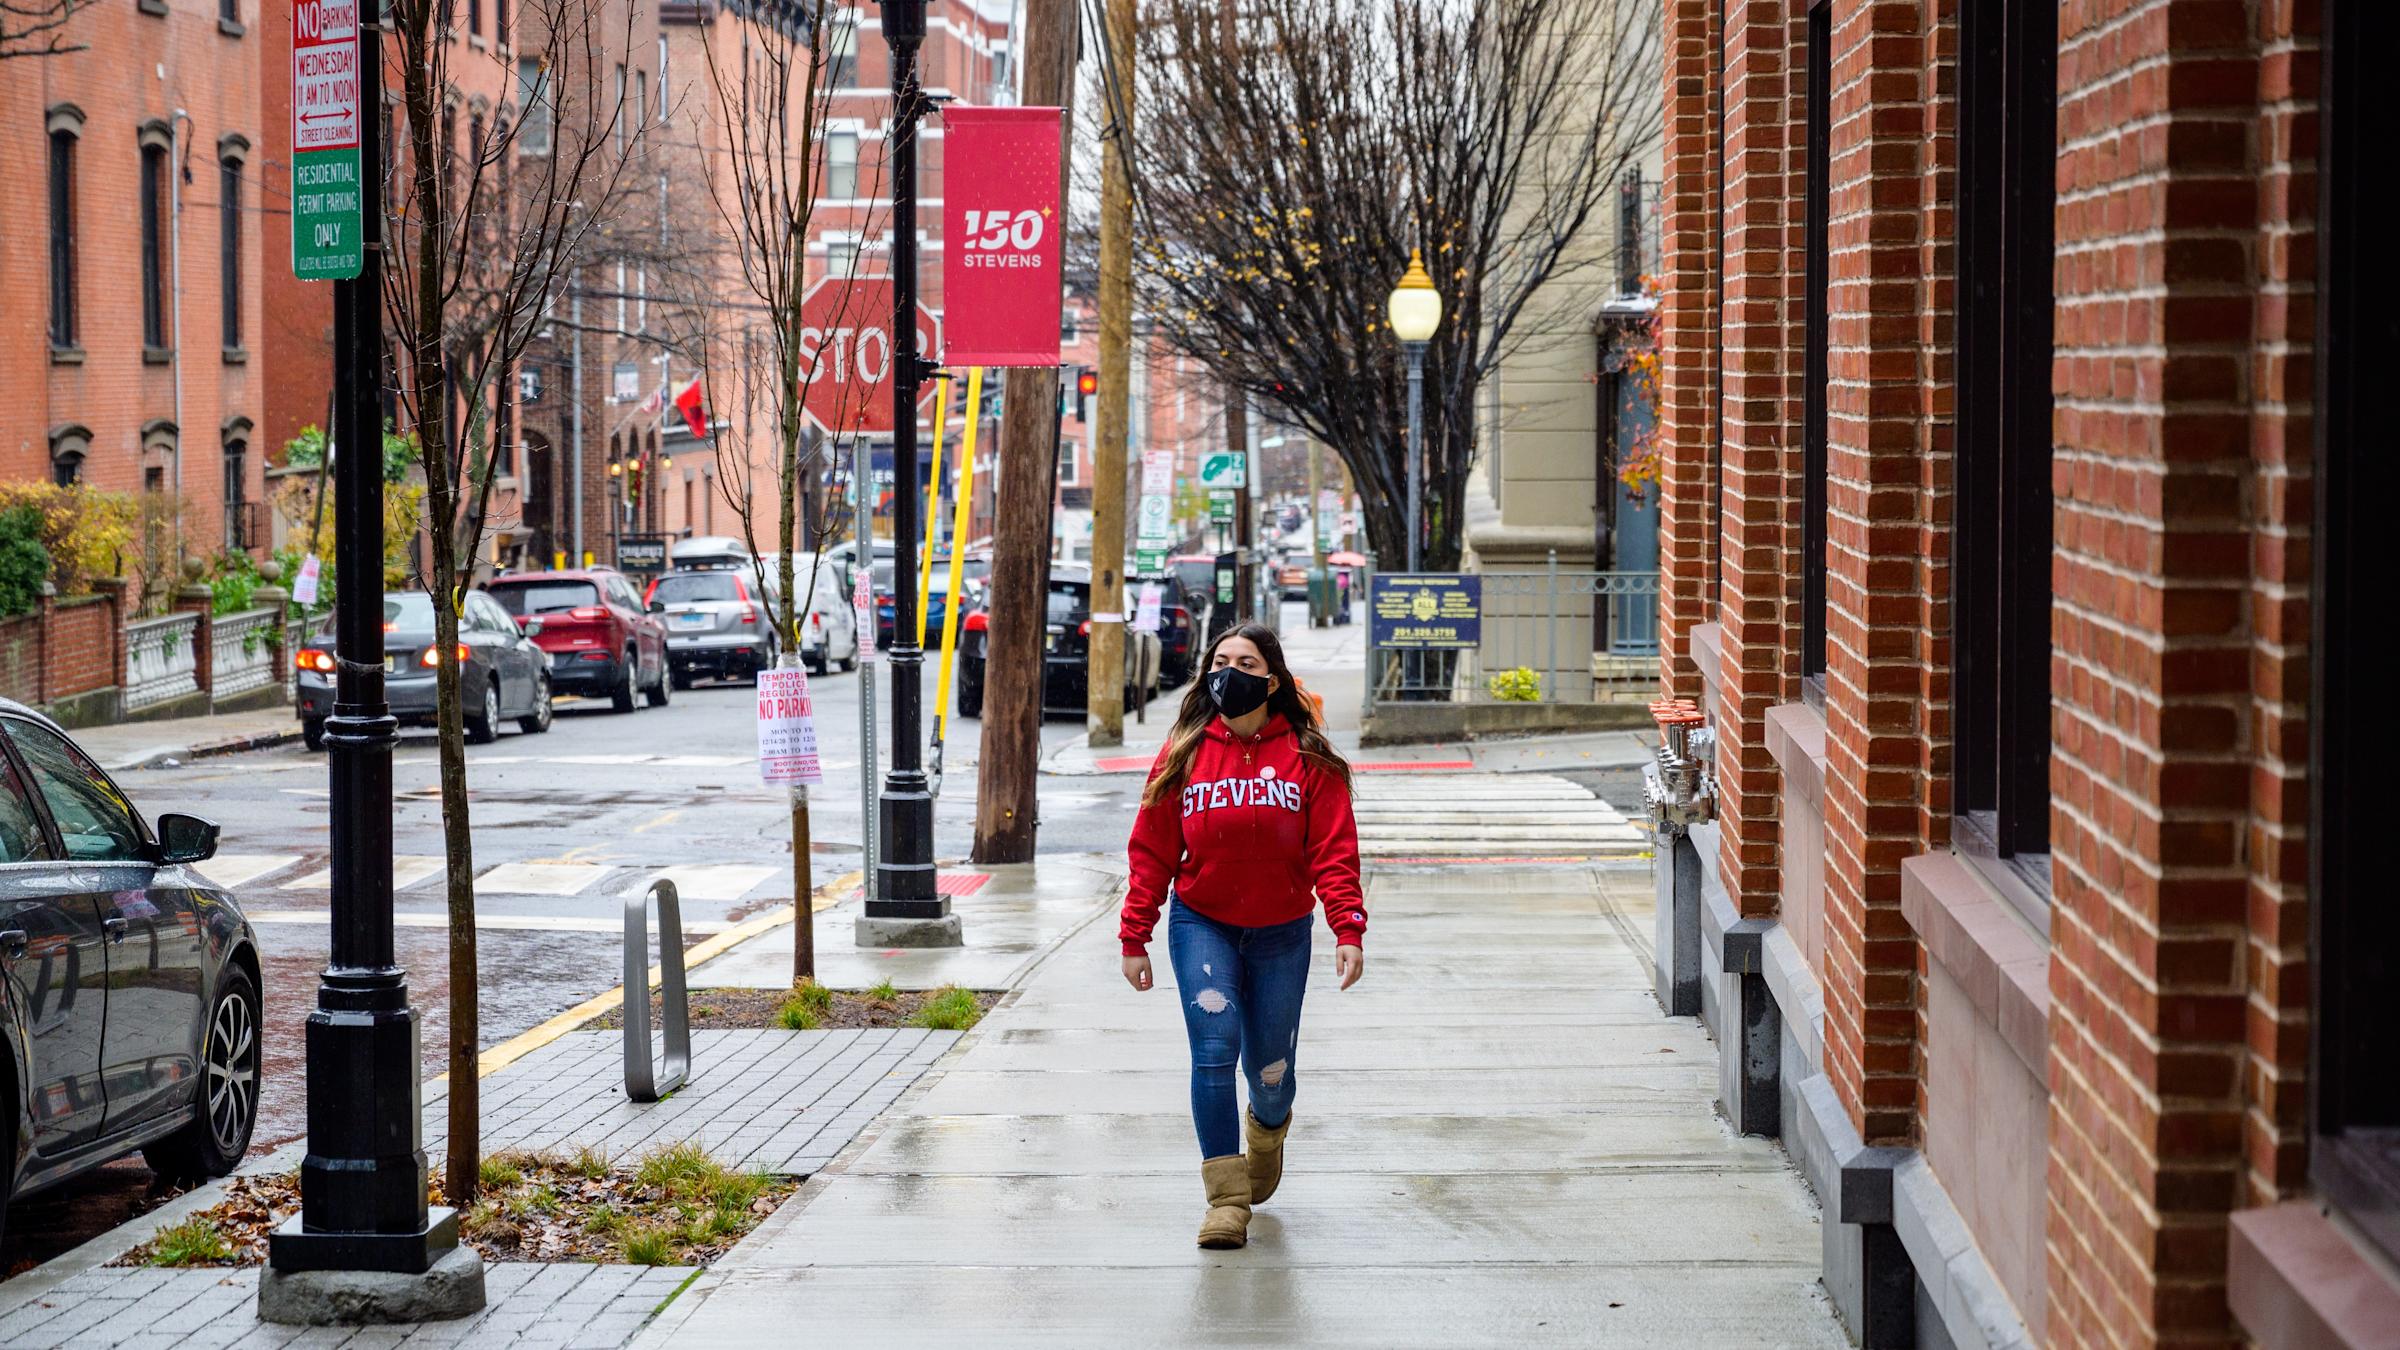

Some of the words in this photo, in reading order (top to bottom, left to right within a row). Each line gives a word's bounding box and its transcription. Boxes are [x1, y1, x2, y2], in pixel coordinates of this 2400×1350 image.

[297, 1, 319, 39] NO
[322, 4, 353, 30] PARKING
[298, 49, 354, 77] WEDNESDAY
[298, 85, 303, 107] 11
[306, 83, 318, 106] AM
[320, 81, 330, 106] TO
[333, 79, 355, 103] NOON
[301, 127, 323, 143] STREET
[324, 124, 353, 140] CLEANING
[298, 162, 355, 185] RESIDENTIAL
[298, 193, 325, 215] PERMIT
[326, 191, 357, 213] PARKING
[314, 222, 341, 248] ONLY
[964, 209, 1044, 250] 150
[964, 254, 1042, 268] STEVENS
[760, 699, 773, 720] NO
[1182, 778, 1301, 818] STEVENS
